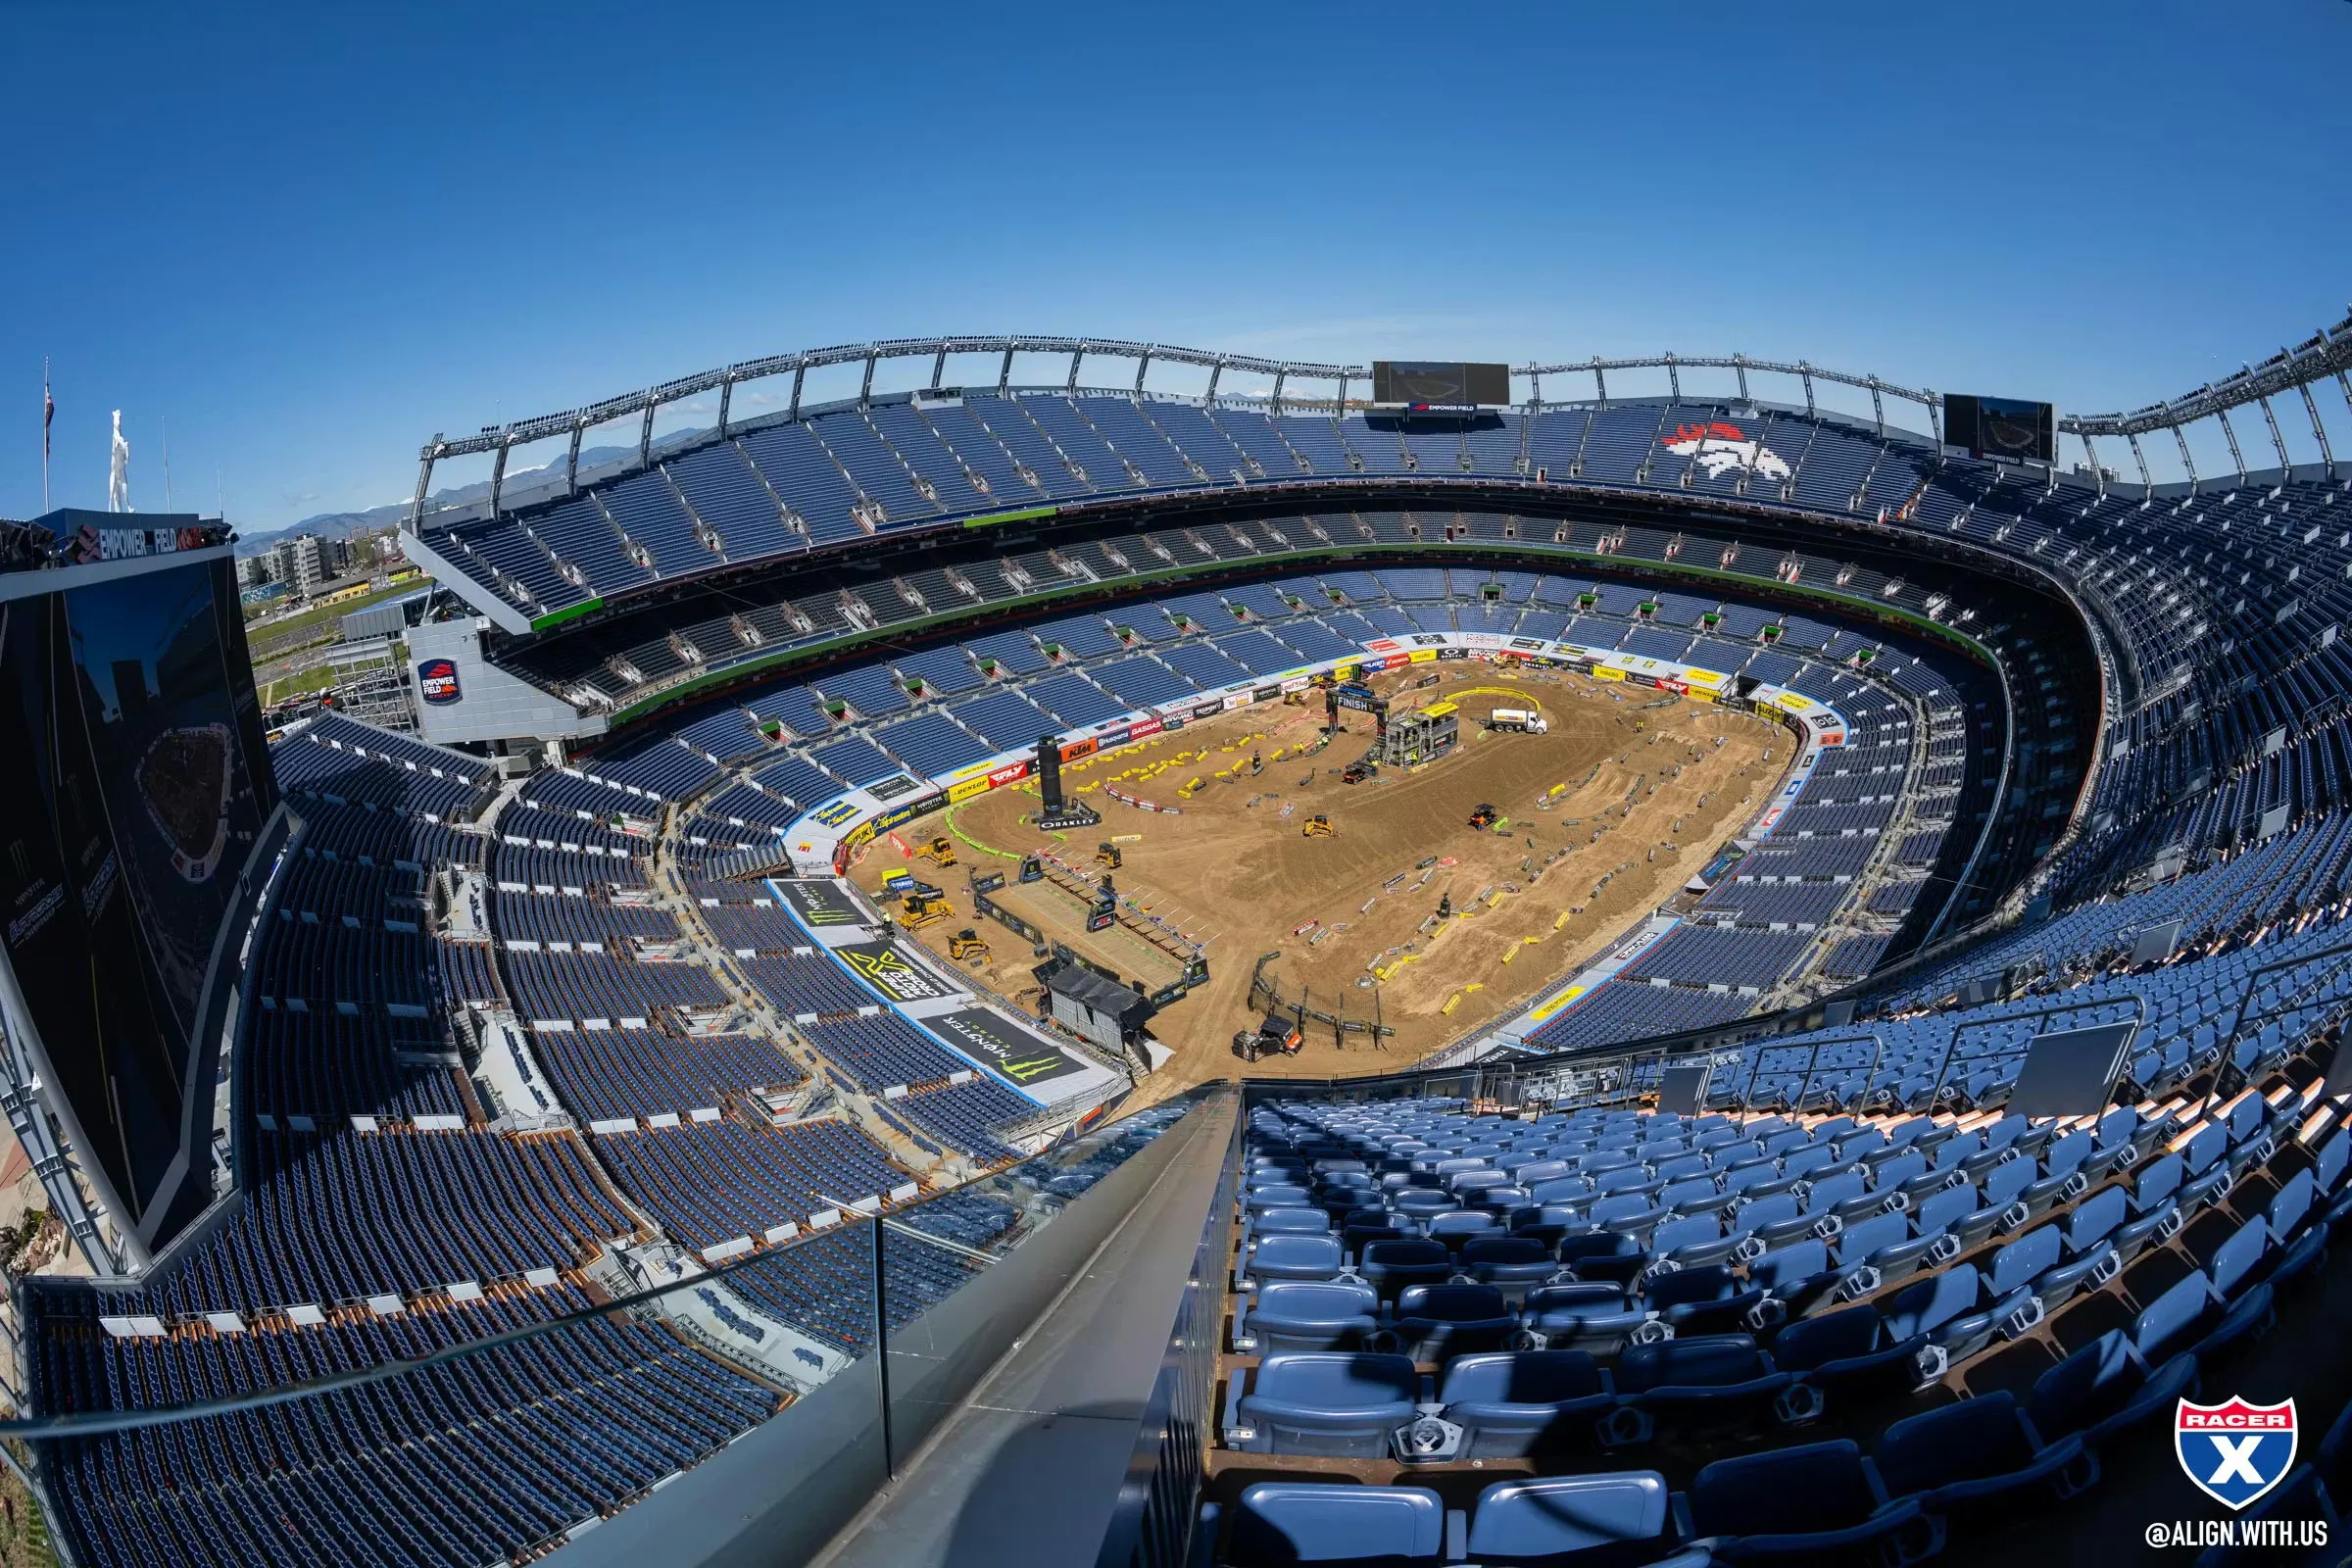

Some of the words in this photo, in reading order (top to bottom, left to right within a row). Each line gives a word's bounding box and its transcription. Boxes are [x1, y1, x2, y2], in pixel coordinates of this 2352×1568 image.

[100, 528, 147, 560] EMPOWER
[155, 527, 177, 554] FIELD
[421, 676, 455, 688] EMPOWER
[423, 685, 442, 695] FIELD
[1338, 697, 1368, 710] FINISH
[1131, 720, 1161, 736] GASGAS
[1068, 745, 1092, 759] KTM
[957, 779, 988, 795] DUNLOP
[1055, 818, 1095, 827] OAKLEY
[877, 971, 918, 999] SUPER
[891, 971, 927, 997] MOTO
[902, 969, 941, 997] CROSS
[942, 1016, 1011, 1059] MONSTER
[964, 1020, 1011, 1050] ENERGY
